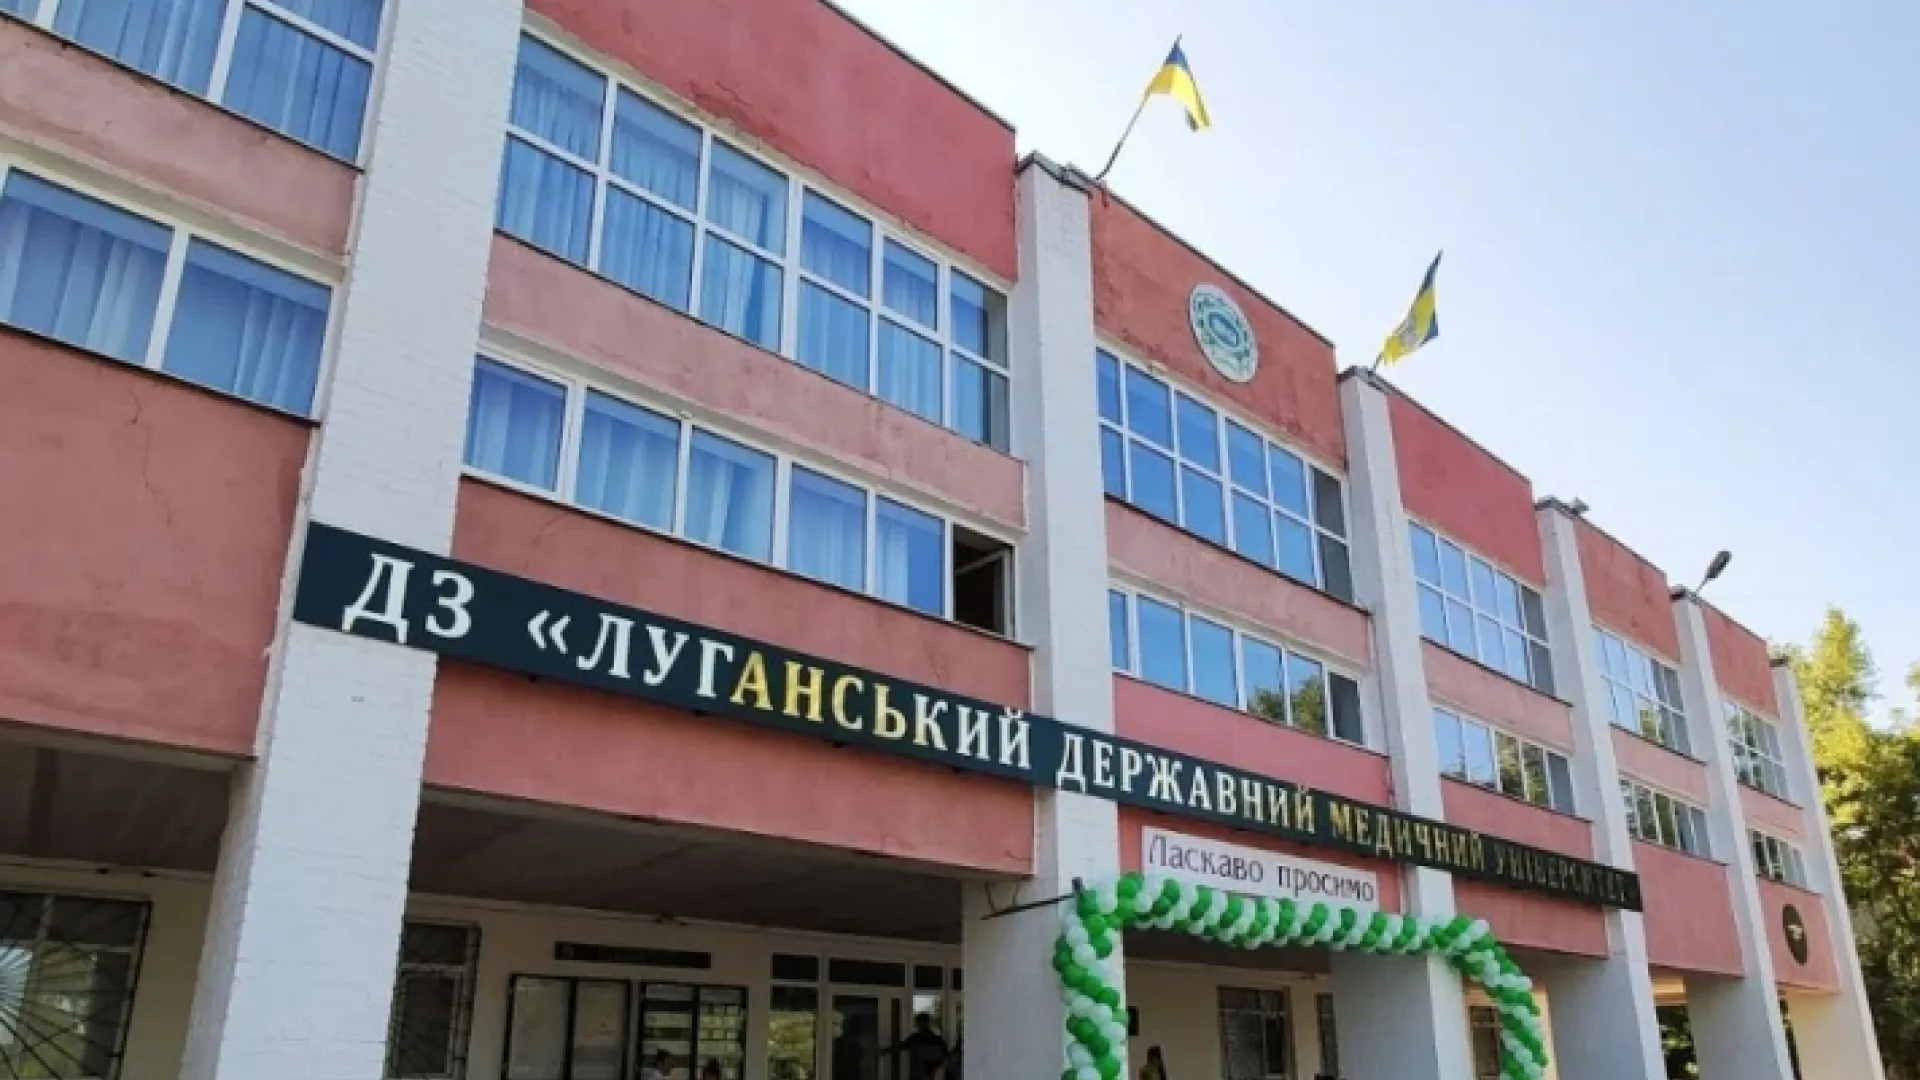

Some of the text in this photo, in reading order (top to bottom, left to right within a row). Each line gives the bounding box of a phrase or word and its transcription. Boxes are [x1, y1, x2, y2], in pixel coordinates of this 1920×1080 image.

[342, 553, 475, 643] ДЗ
[527, 608, 1032, 769] «ЛУГАНСЬКИЙ
[1056, 732, 1316, 835] ДЕРЖАВНИЙ
[1328, 800, 1485, 872] МЕДИЧНИЙ
[1149, 833, 1375, 902] Ласкаво просимо
